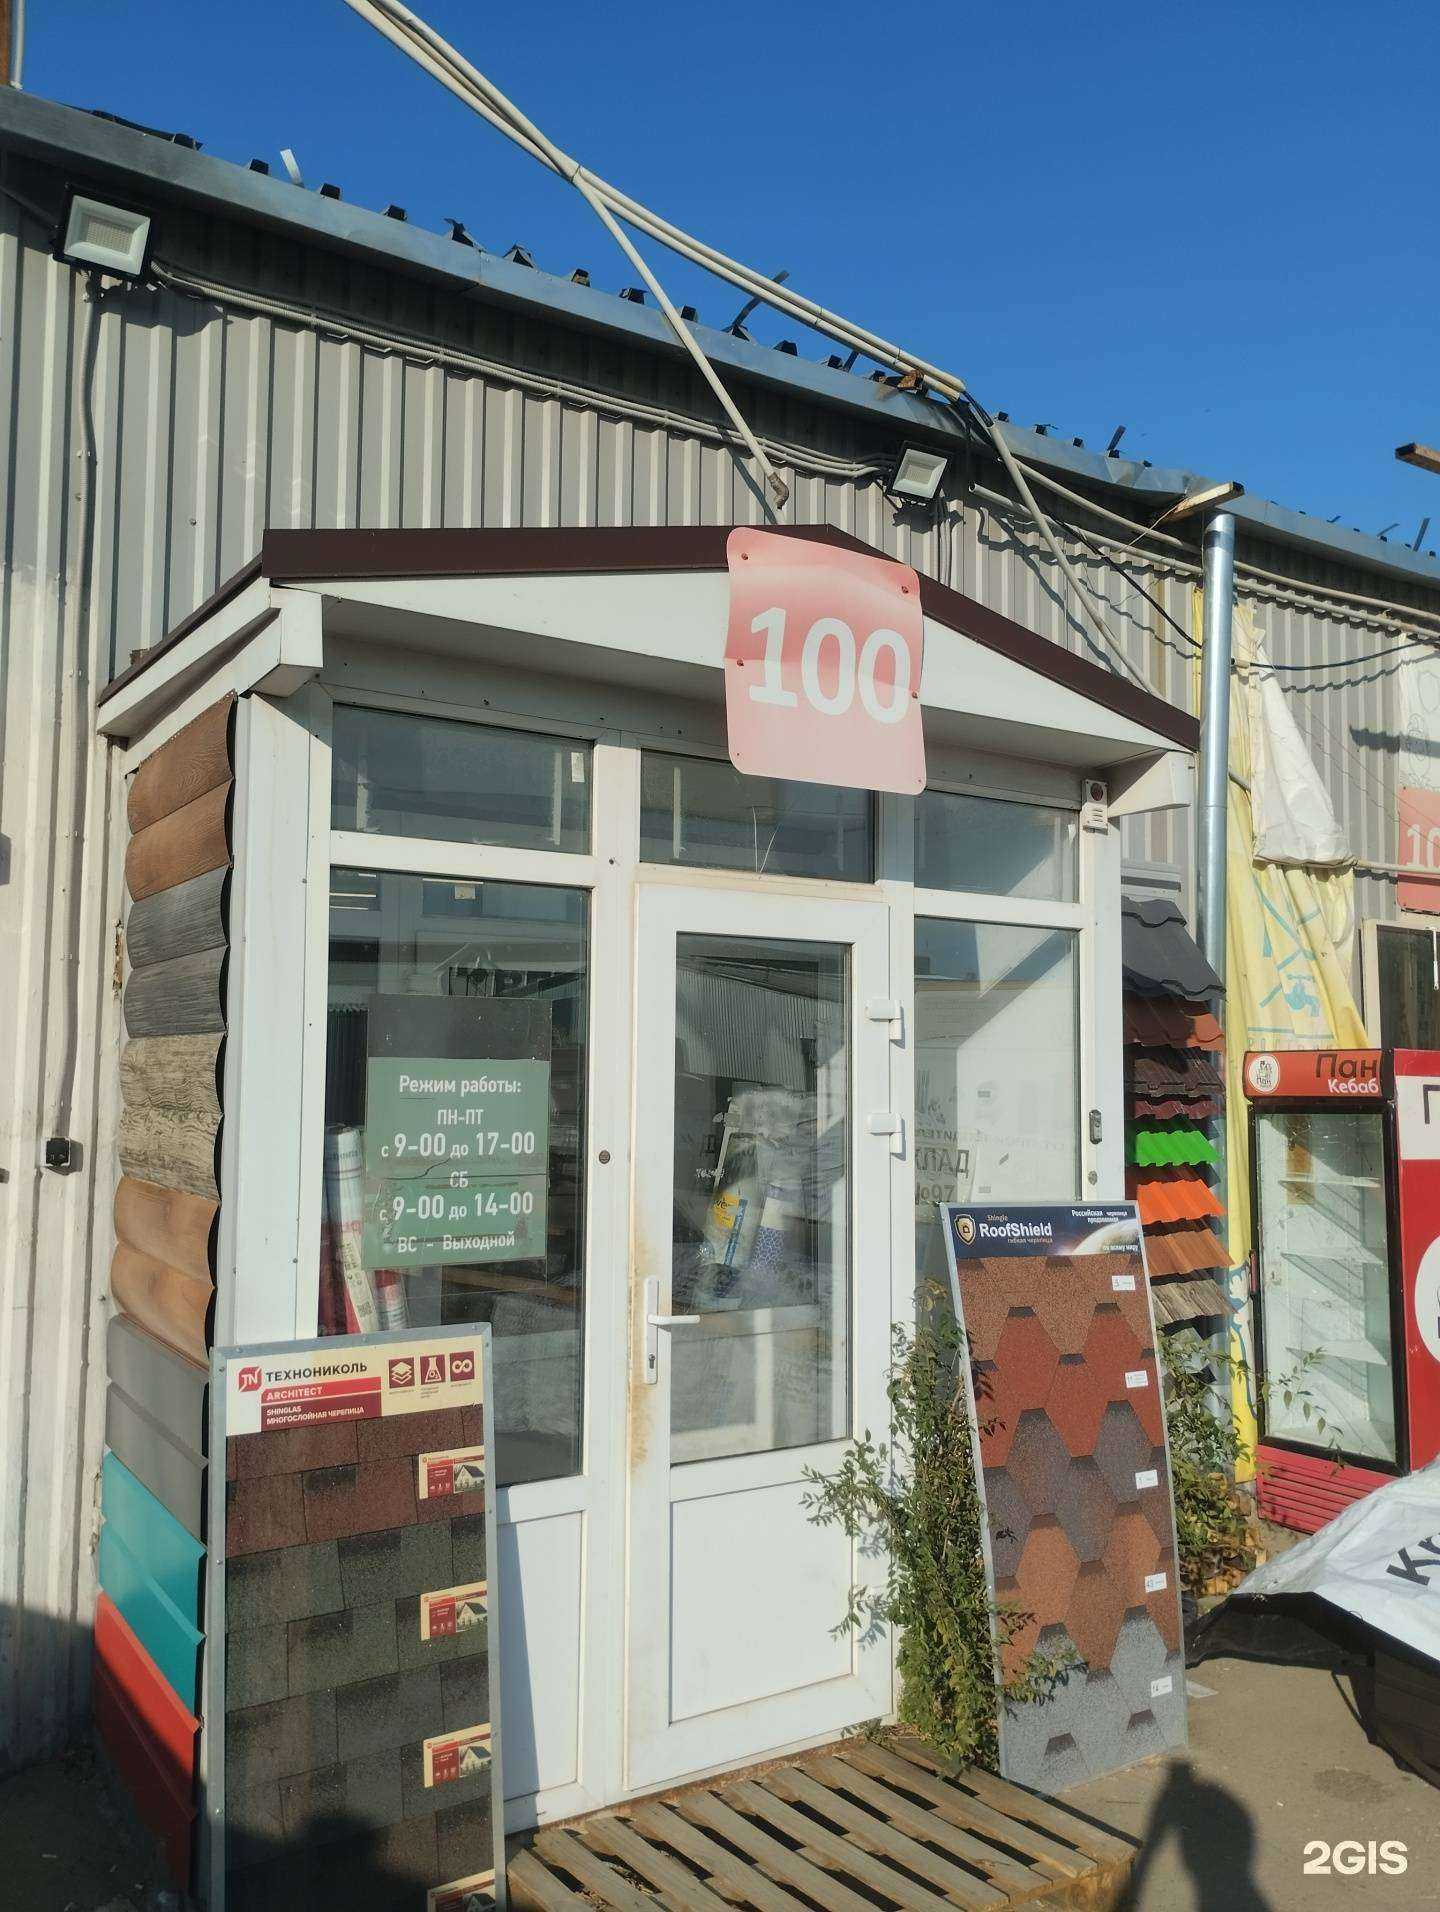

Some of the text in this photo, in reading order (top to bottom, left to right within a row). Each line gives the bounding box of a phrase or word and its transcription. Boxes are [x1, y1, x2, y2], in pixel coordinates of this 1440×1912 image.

[749, 607, 911, 724] 100
[1315, 1053, 1378, 1078] Пан
[399, 1075, 522, 1097] Режим работы:
[1328, 1078, 1379, 1094] Кебаб
[437, 1109, 484, 1125] ПН-ПТ
[381, 1131, 535, 1159] с 9-00 до 17-00
[450, 1171, 469, 1188] СБ
[379, 1191, 533, 1221] с 9-00 до 14-00
[979, 1222, 1053, 1238] RoofShield
[397, 1236, 418, 1253] ВС
[443, 1230, 515, 1250] Выходной
[266, 1363, 368, 1382] ТЕХНОНИКОЛЬ
[266, 1386, 323, 1401] ARCHITECT
[266, 1405, 302, 1416] SHINGLAS
[266, 1406, 365, 1425] МНОГОСЛОЙНАЯ ЧЕРЕПИЦА
